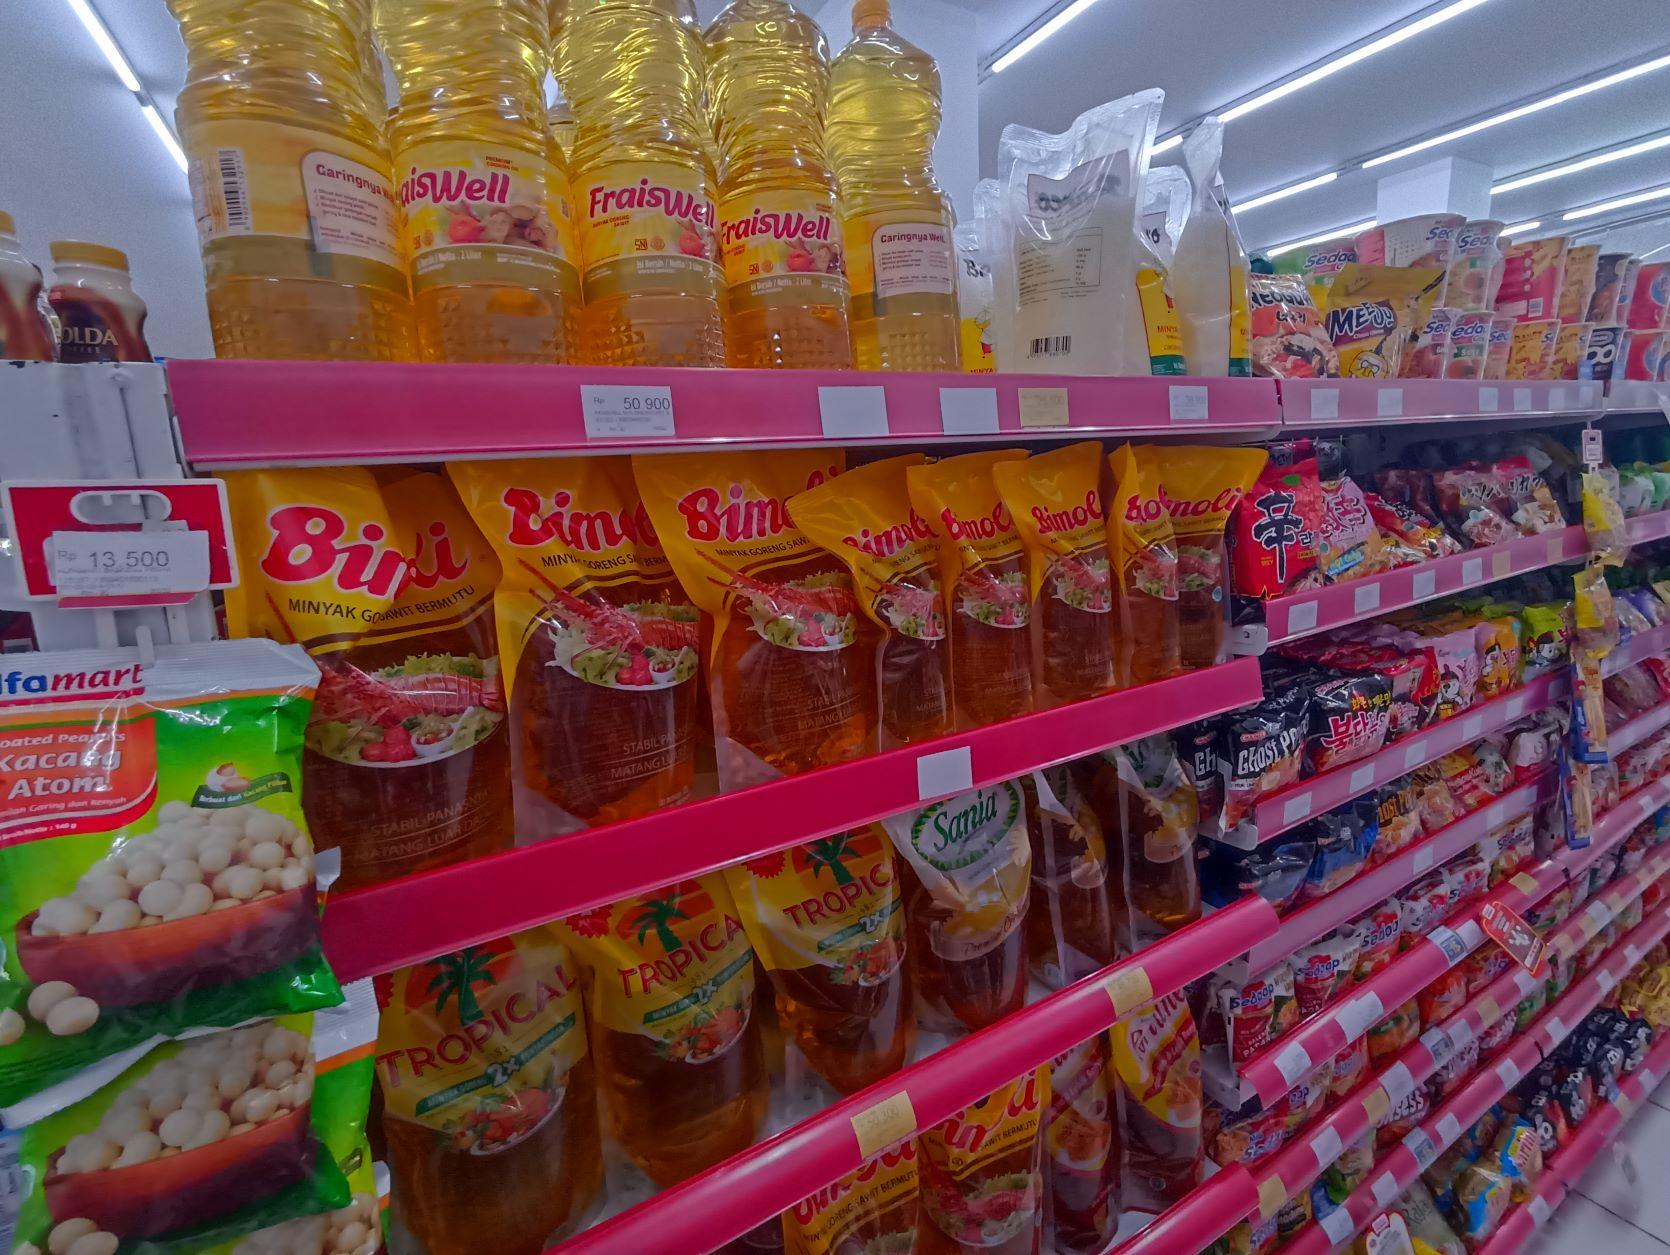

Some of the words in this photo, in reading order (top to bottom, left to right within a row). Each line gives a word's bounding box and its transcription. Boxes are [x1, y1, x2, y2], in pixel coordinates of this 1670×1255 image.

[402, 167, 510, 207] aisWell
[590, 178, 715, 230] FraisWell
[59, 326, 119, 346] OLDA
[1032, 490, 1102, 534] Bimol
[786, 536, 810, 549] SAWI
[1252, 491, 1304, 584] 辛
[288, 598, 357, 619] MINYAK
[414, 585, 476, 614] BERMUTU
[0, 733, 53, 748] oated
[933, 789, 999, 853] Sania
[782, 857, 900, 930] TROPIC
[617, 913, 746, 998] TROPICA
[375, 964, 578, 1088] TROPICAL
